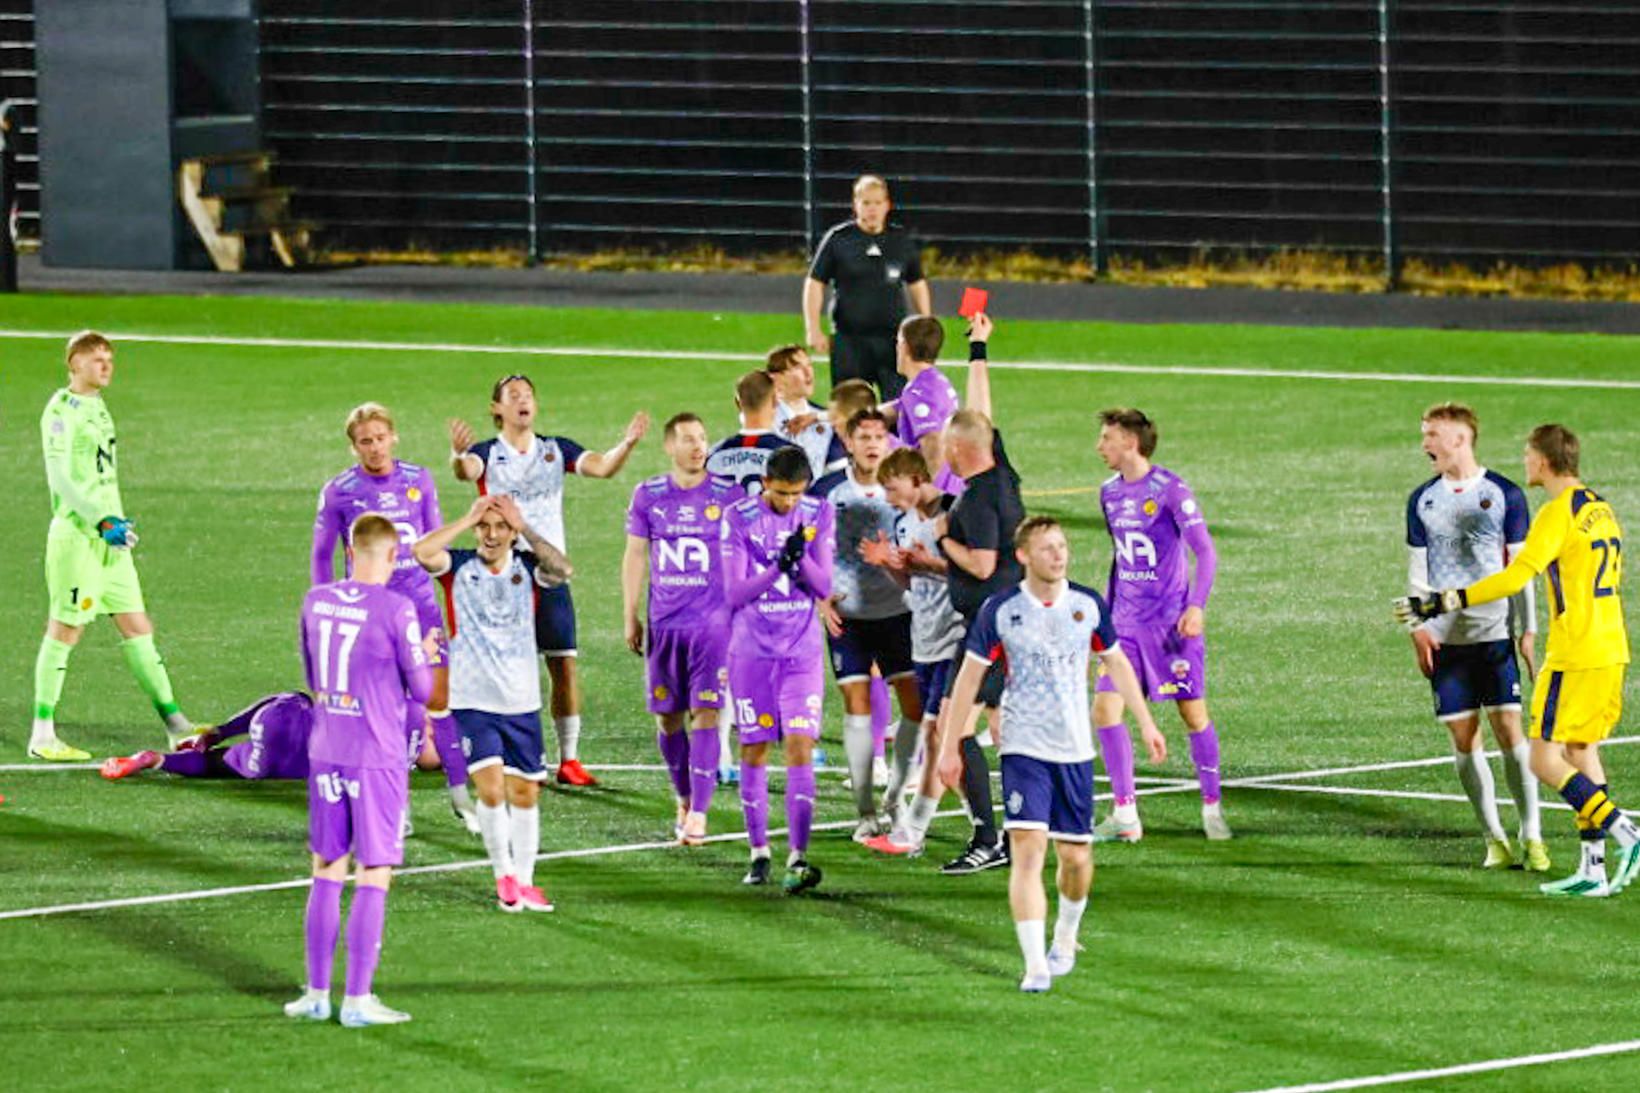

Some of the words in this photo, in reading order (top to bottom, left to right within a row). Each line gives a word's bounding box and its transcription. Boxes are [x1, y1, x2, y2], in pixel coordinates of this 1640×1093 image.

[659, 536, 709, 573] NA
[70, 586, 79, 605] 1
[319, 619, 361, 692] 17
